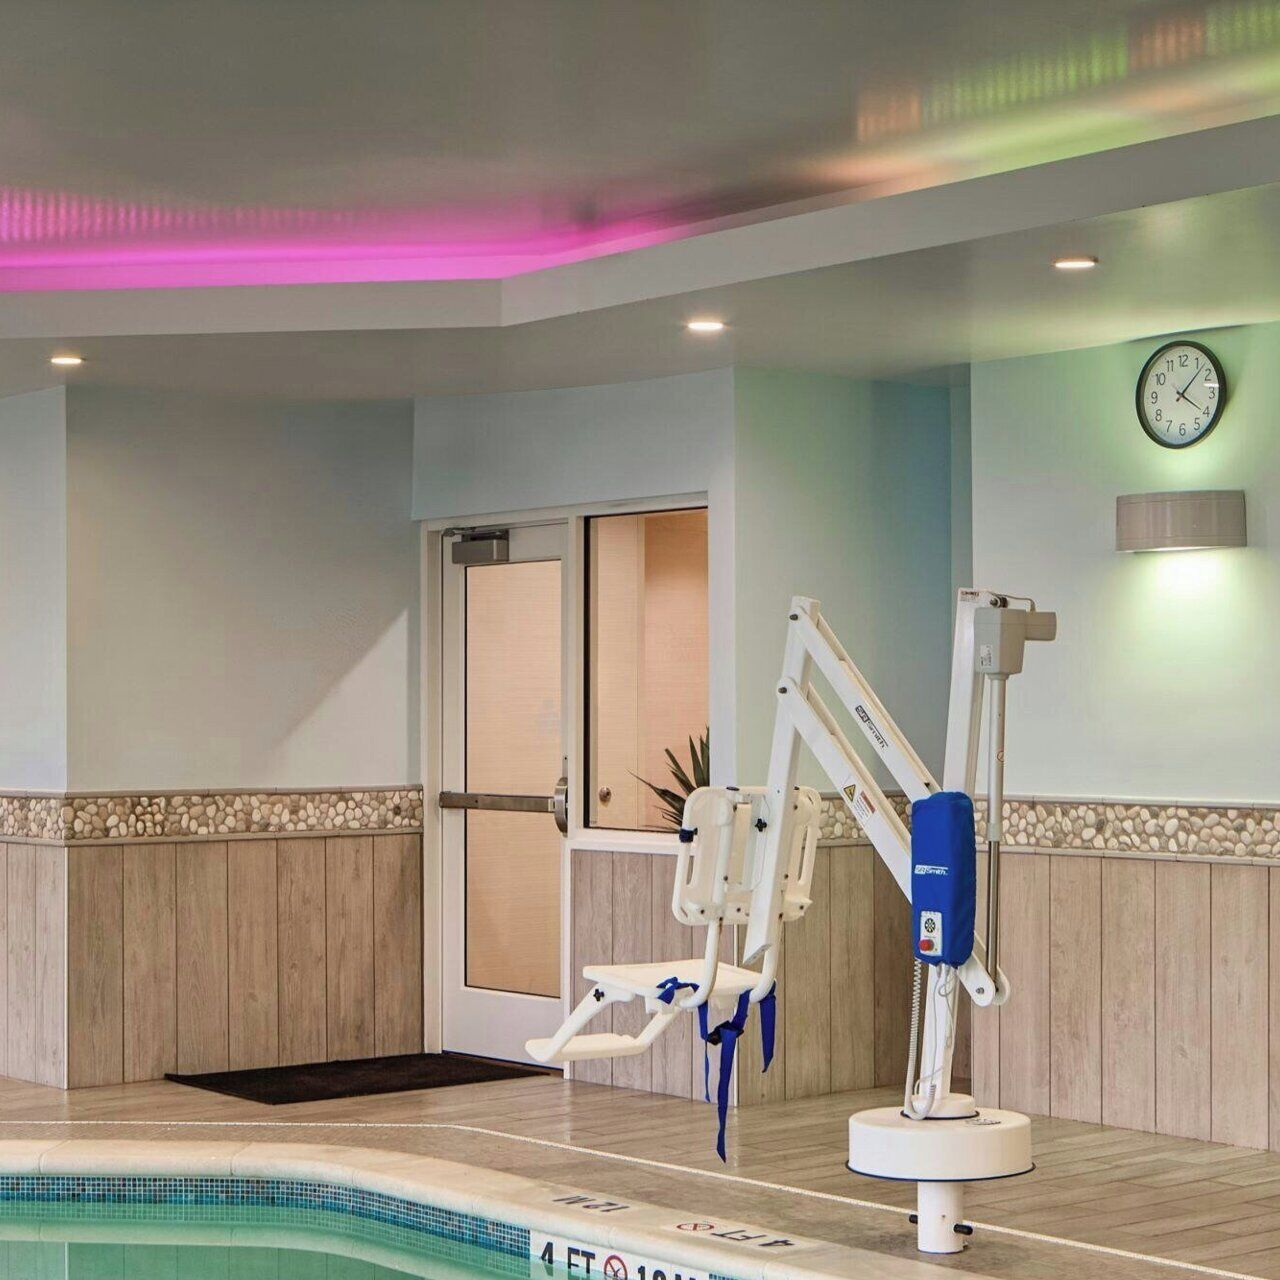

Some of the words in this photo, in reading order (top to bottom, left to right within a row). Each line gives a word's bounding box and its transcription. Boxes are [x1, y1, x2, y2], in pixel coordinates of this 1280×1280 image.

[1166, 360, 1174, 372] 11
[1178, 354, 1188, 367] 12
[1155, 373, 1166, 386] 10
[1205, 368, 1211, 381] 2
[1151, 392, 1158, 404] 9
[1208, 387, 1215, 399] 3
[1155, 409, 1162, 421] 8
[1202, 406, 1210, 417] 4
[1166, 420, 1172, 433] 7
[1179, 423, 1186, 436] 6
[1194, 418, 1200, 430] 5
[710, 1229, 767, 1242] FT
[540, 1241, 554, 1265] 4
[567, 1247, 596, 1274] FT
